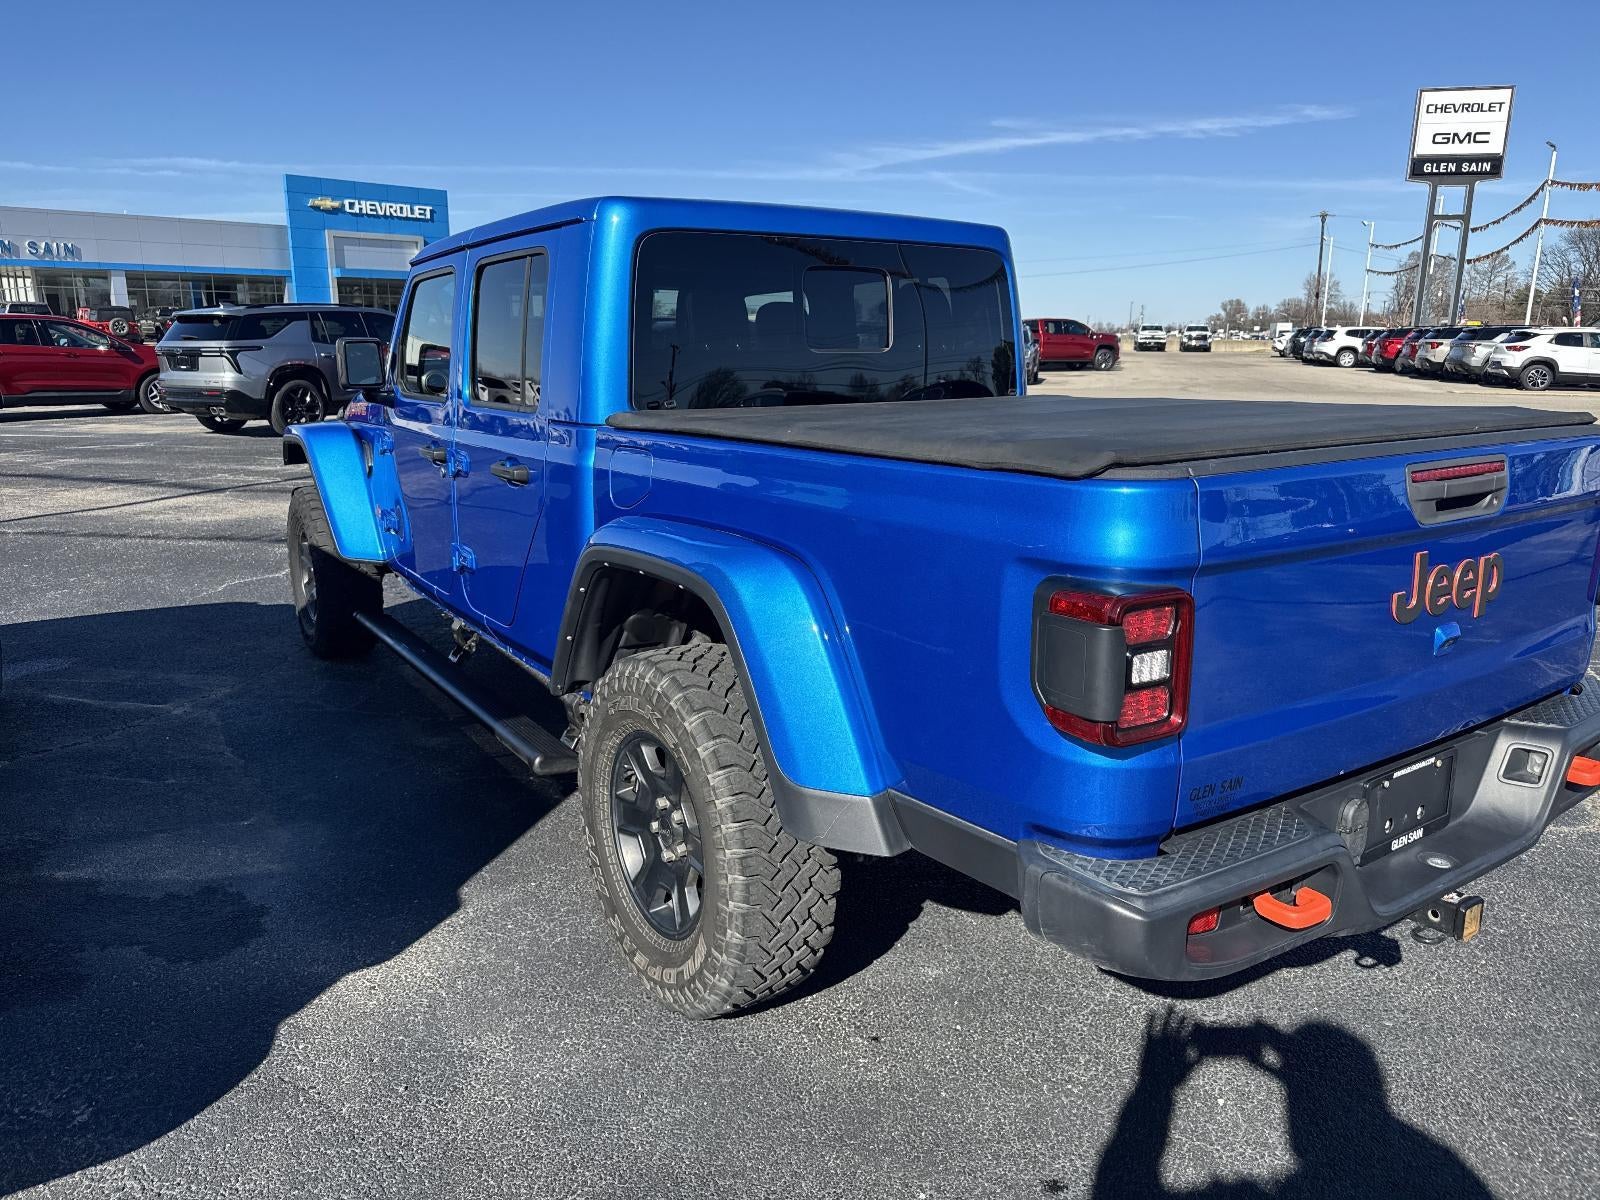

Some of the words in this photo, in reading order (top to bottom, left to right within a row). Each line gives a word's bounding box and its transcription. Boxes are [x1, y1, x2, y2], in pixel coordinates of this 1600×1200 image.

[1426, 102, 1506, 114] CHEVROLET
[1432, 132, 1491, 145] GMC
[1423, 163, 1457, 173] GLEN
[1461, 162, 1491, 172] SAIN
[343, 199, 434, 220] CHEVROLET
[26, 240, 77, 259] SAIN
[1390, 550, 1504, 625] Jeep
[1189, 783, 1217, 802] GLEN
[1219, 775, 1245, 794] SAIN
[1391, 834, 1409, 851] GLEN
[1407, 828, 1424, 844] SAIN
